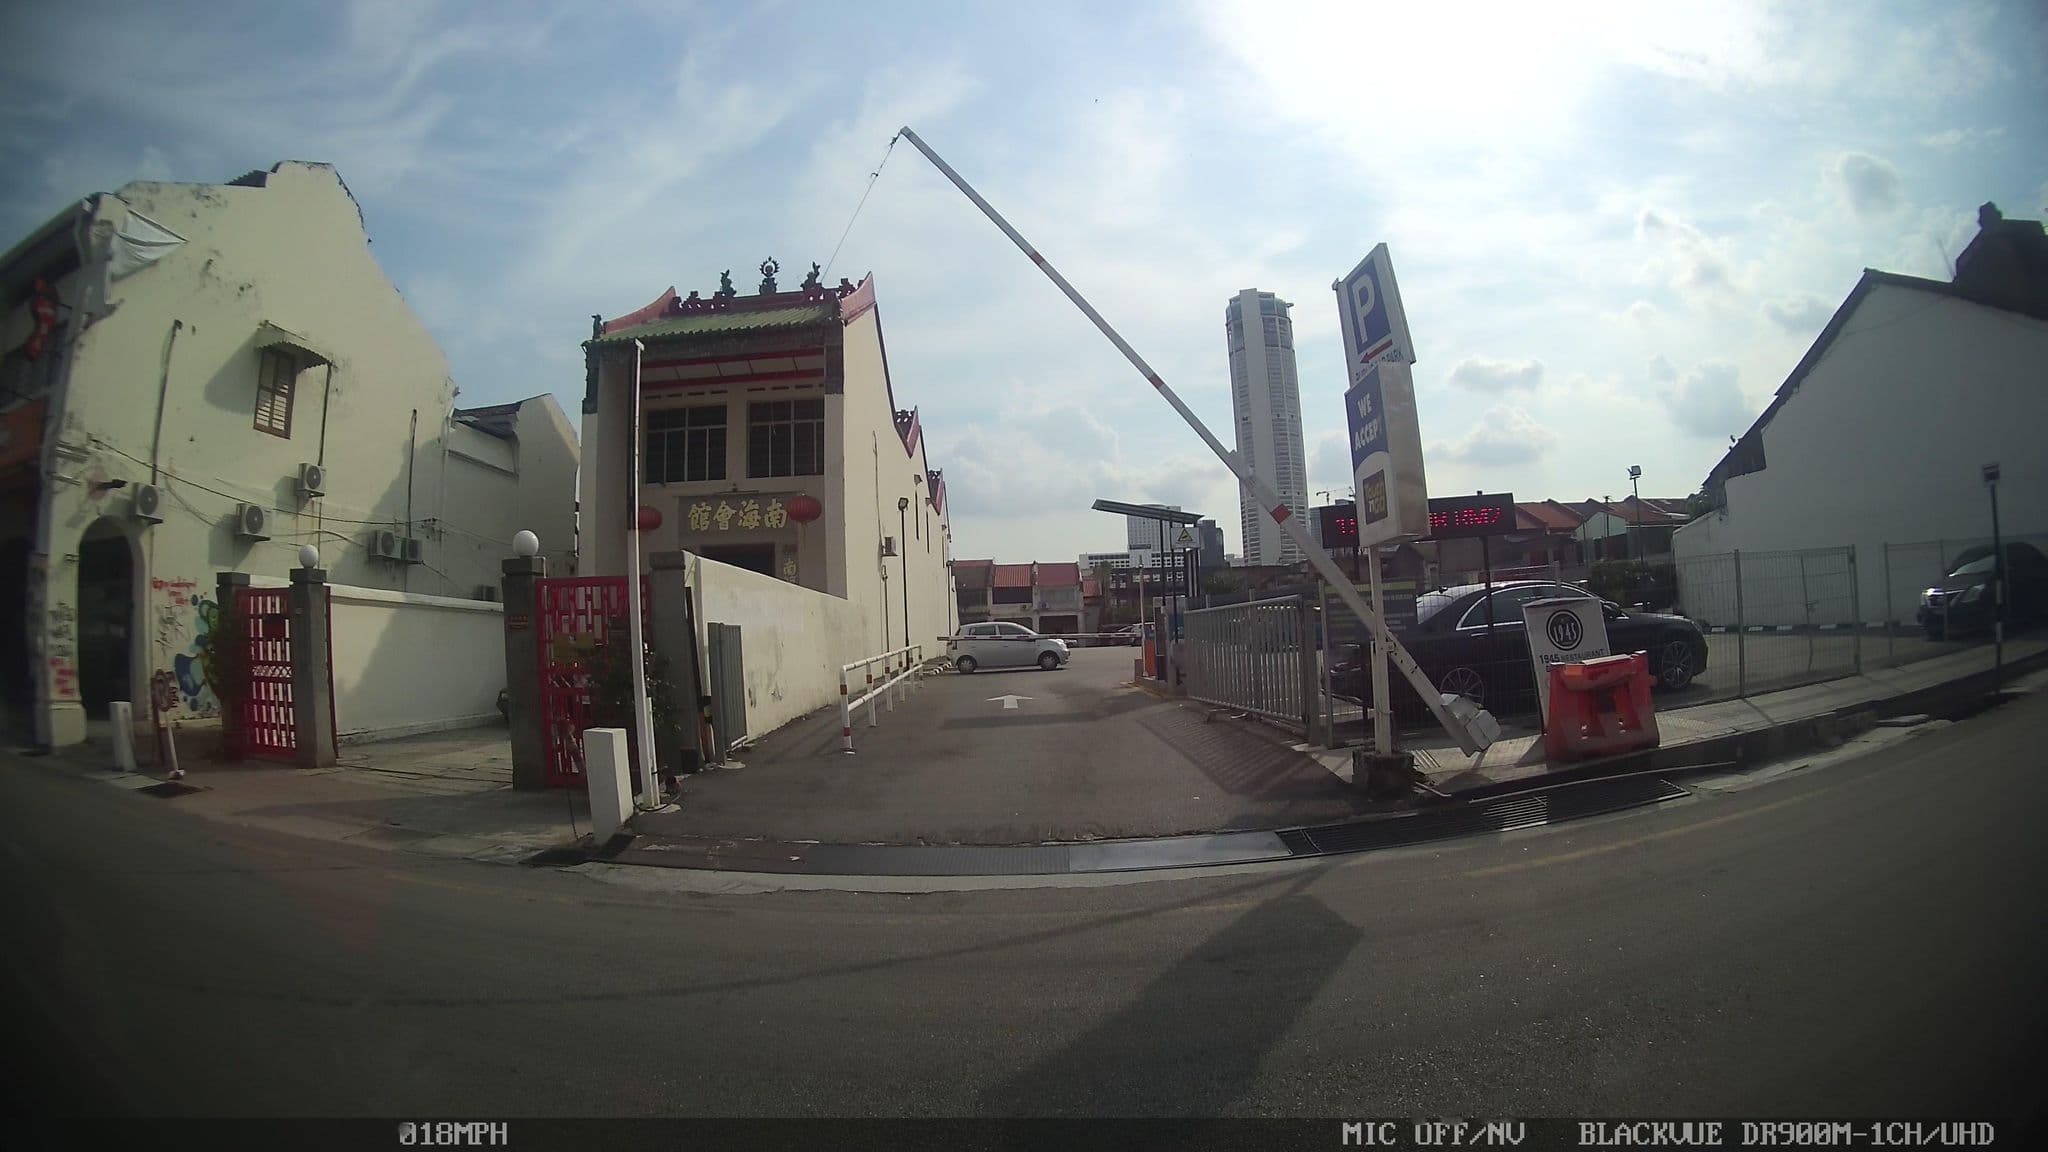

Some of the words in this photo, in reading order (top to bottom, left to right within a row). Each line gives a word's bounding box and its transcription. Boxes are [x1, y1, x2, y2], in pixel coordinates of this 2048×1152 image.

[1352, 274, 1375, 344] P
[1357, 393, 1373, 418] WE
[1553, 623, 1577, 642] 1945
[1540, 654, 1560, 664] 1945
